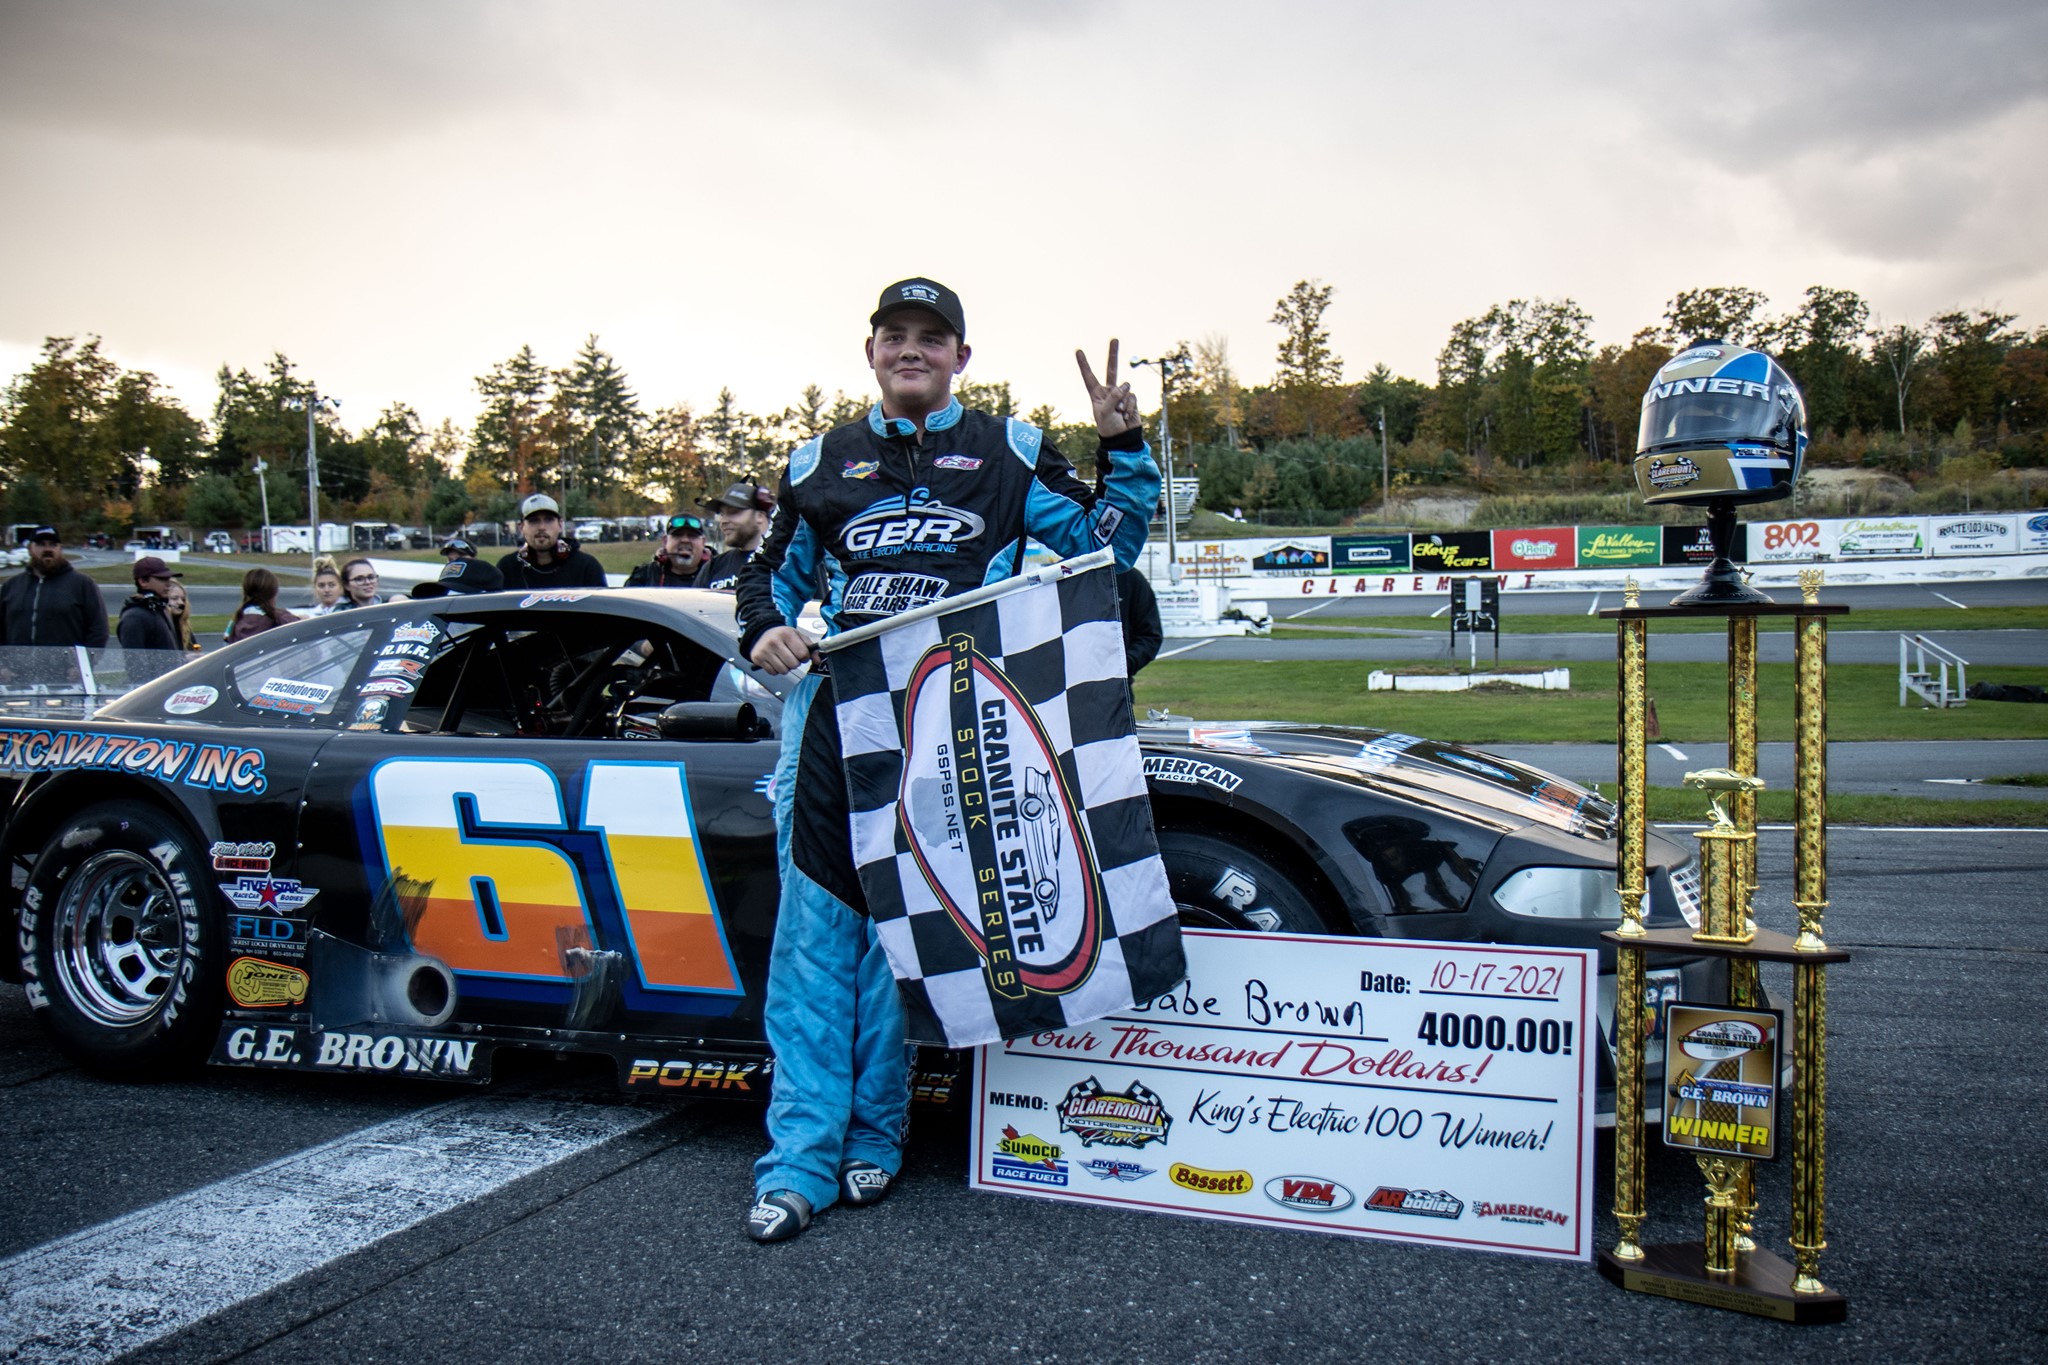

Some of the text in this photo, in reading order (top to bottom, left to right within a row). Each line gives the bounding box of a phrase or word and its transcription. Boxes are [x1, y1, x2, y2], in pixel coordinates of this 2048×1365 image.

[846, 518, 962, 551] GBR
[1764, 522, 1820, 550] 802
[1939, 522, 2006, 536] ROUTE 103 AUTO
[872, 542, 912, 558] BROWN
[913, 542, 959, 554] RACING
[1413, 543, 1460, 559] EKeys
[1512, 539, 1556, 556] O'Reilly
[1682, 544, 1704, 552] BLACK
[1764, 550, 1793, 559] credit
[1444, 555, 1490, 567] 4cars
[851, 576, 944, 598] DALE SHAW
[1302, 573, 1536, 594] CLAREMNT
[845, 596, 911, 612] RACE CARS
[380, 643, 430, 659] R.W.R.
[188, 745, 267, 794] INC.
[1143, 755, 1244, 793] MERICAN
[1156, 773, 1196, 783] RACER
[937, 743, 964, 852] GSPSS.NET
[953, 643, 1016, 987] PRO STOCK SERIES
[981, 698, 1045, 956] GRANITE STATE
[240, 879, 300, 894] FIVE STAR
[370, 756, 746, 998] 61
[280, 894, 304, 902] BODIES
[150, 841, 199, 1028] AMERICAN
[236, 917, 295, 941] FLD
[20, 886, 50, 1011] RACER
[243, 971, 302, 981] JONES
[1360, 960, 1565, 995] Date: 10-17-2021
[1245, 978, 1364, 1035] Brown
[1417, 1011, 1573, 1055] 4000.00!
[1696, 1029, 1757, 1042] GRANITE STATE
[227, 1027, 478, 1072] G.E. BROWN
[1005, 1024, 1494, 1084] our Thousand Dollars!
[989, 1091, 1048, 1111] MEMO:
[1679, 1085, 1769, 1108] G.E. BROWN
[1068, 1098, 1161, 1124] CLAREMONT
[1189, 1088, 1554, 1151] King's Electric 100 Winner!
[1067, 1117, 1160, 1133] MOTORSPORTS
[1669, 1115, 1769, 1146] WINNER
[1001, 1139, 1060, 1159] SUNOCO
[1080, 1131, 1141, 1147] Park
[996, 1168, 1065, 1183] RACE FUELS
[1092, 1159, 1141, 1172] FIVE STAR
[1175, 1167, 1245, 1192] Bassett
[1282, 1178, 1336, 1200] VDL
[1300, 1198, 1330, 1206] SYSTEMS
[1367, 1188, 1407, 1208] AR
[1402, 1194, 1460, 1213] bodies
[1478, 1201, 1569, 1226] AMERICAN
[1500, 1216, 1545, 1225] RACER
